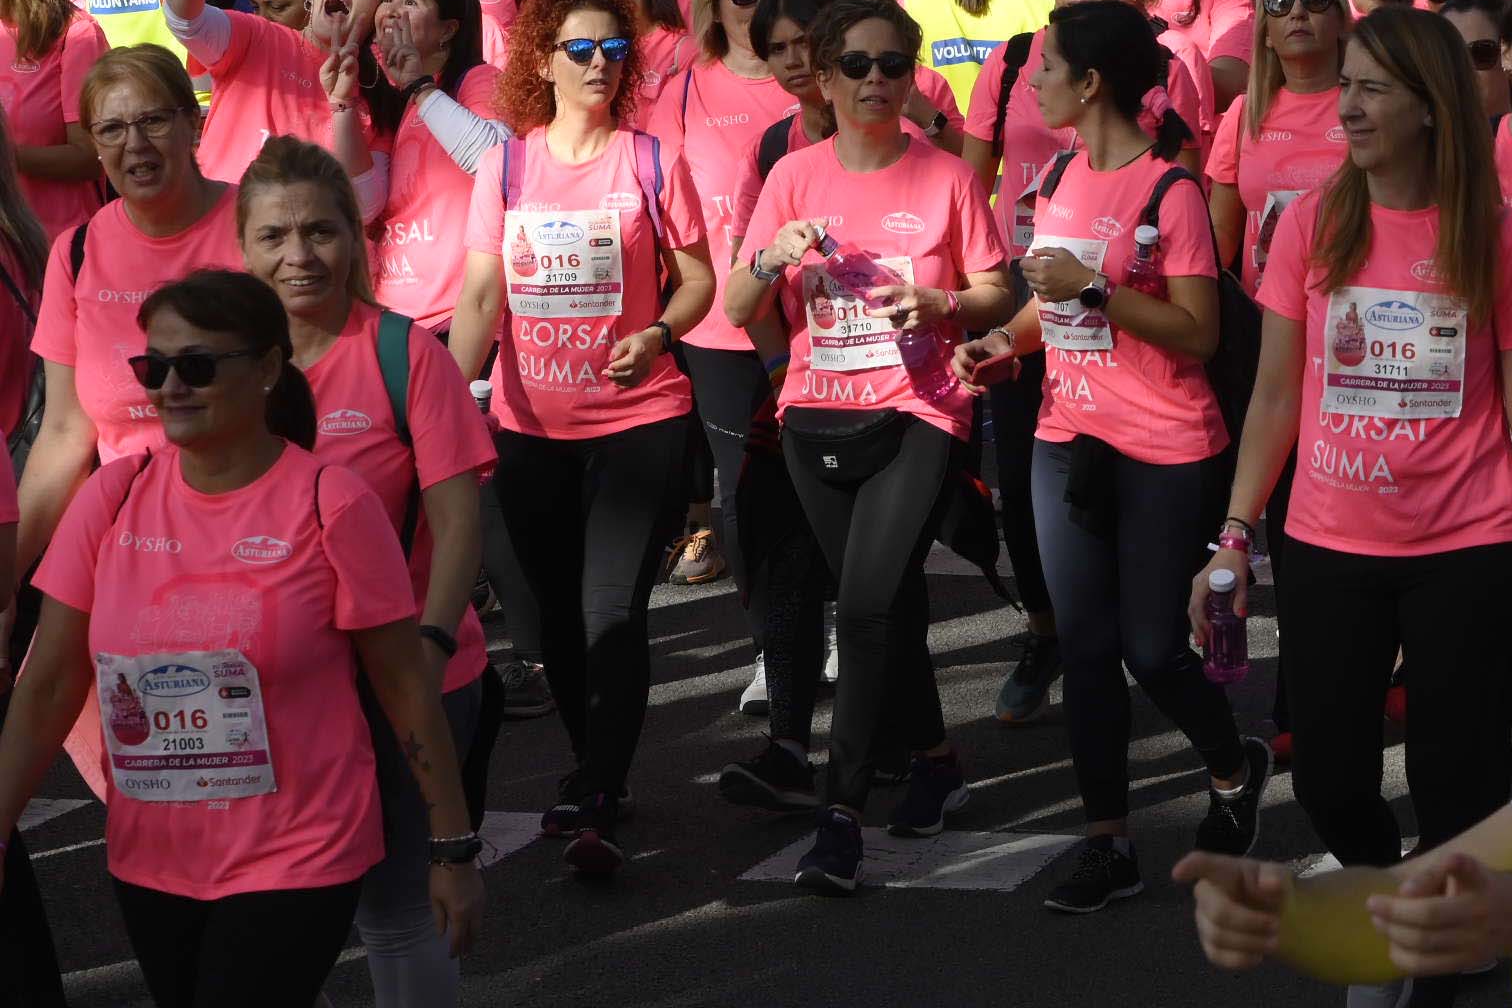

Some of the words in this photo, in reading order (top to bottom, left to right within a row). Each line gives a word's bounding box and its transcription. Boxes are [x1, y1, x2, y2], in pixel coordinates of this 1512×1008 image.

[706, 113, 750, 128] OYSHO
[384, 219, 434, 247] RSAL
[540, 253, 582, 270] 016
[545, 272, 578, 283] 31709
[1369, 308, 1420, 326] ASTURIANA
[840, 322, 873, 335] 31710
[1370, 339, 1417, 360] 016
[518, 351, 598, 384] SUMA
[1374, 363, 1409, 377] 31711
[801, 369, 878, 405] SUMA
[1339, 377, 1377, 389] CARRERA
[1377, 380, 1389, 389] DE
[1389, 380, 1400, 389] LA
[1400, 380, 1429, 390] MUJER
[1431, 382, 1450, 390] 2023
[1336, 393, 1377, 407] OYSHO
[1408, 398, 1453, 409] Santander
[1310, 439, 1394, 483] SUMA
[119, 530, 182, 554] OYSHO
[213, 668, 246, 679] SUMA
[143, 673, 207, 693] ASTURIANA
[153, 708, 209, 732] 016
[162, 736, 205, 752] 21003
[124, 757, 168, 768] CARRERA
[168, 757, 182, 767] DE
[182, 756, 196, 766] LA
[196, 755, 229, 767] MUJER
[232, 754, 254, 765] 2023
[124, 777, 171, 790] OYSHO
[208, 774, 262, 787] Santander
